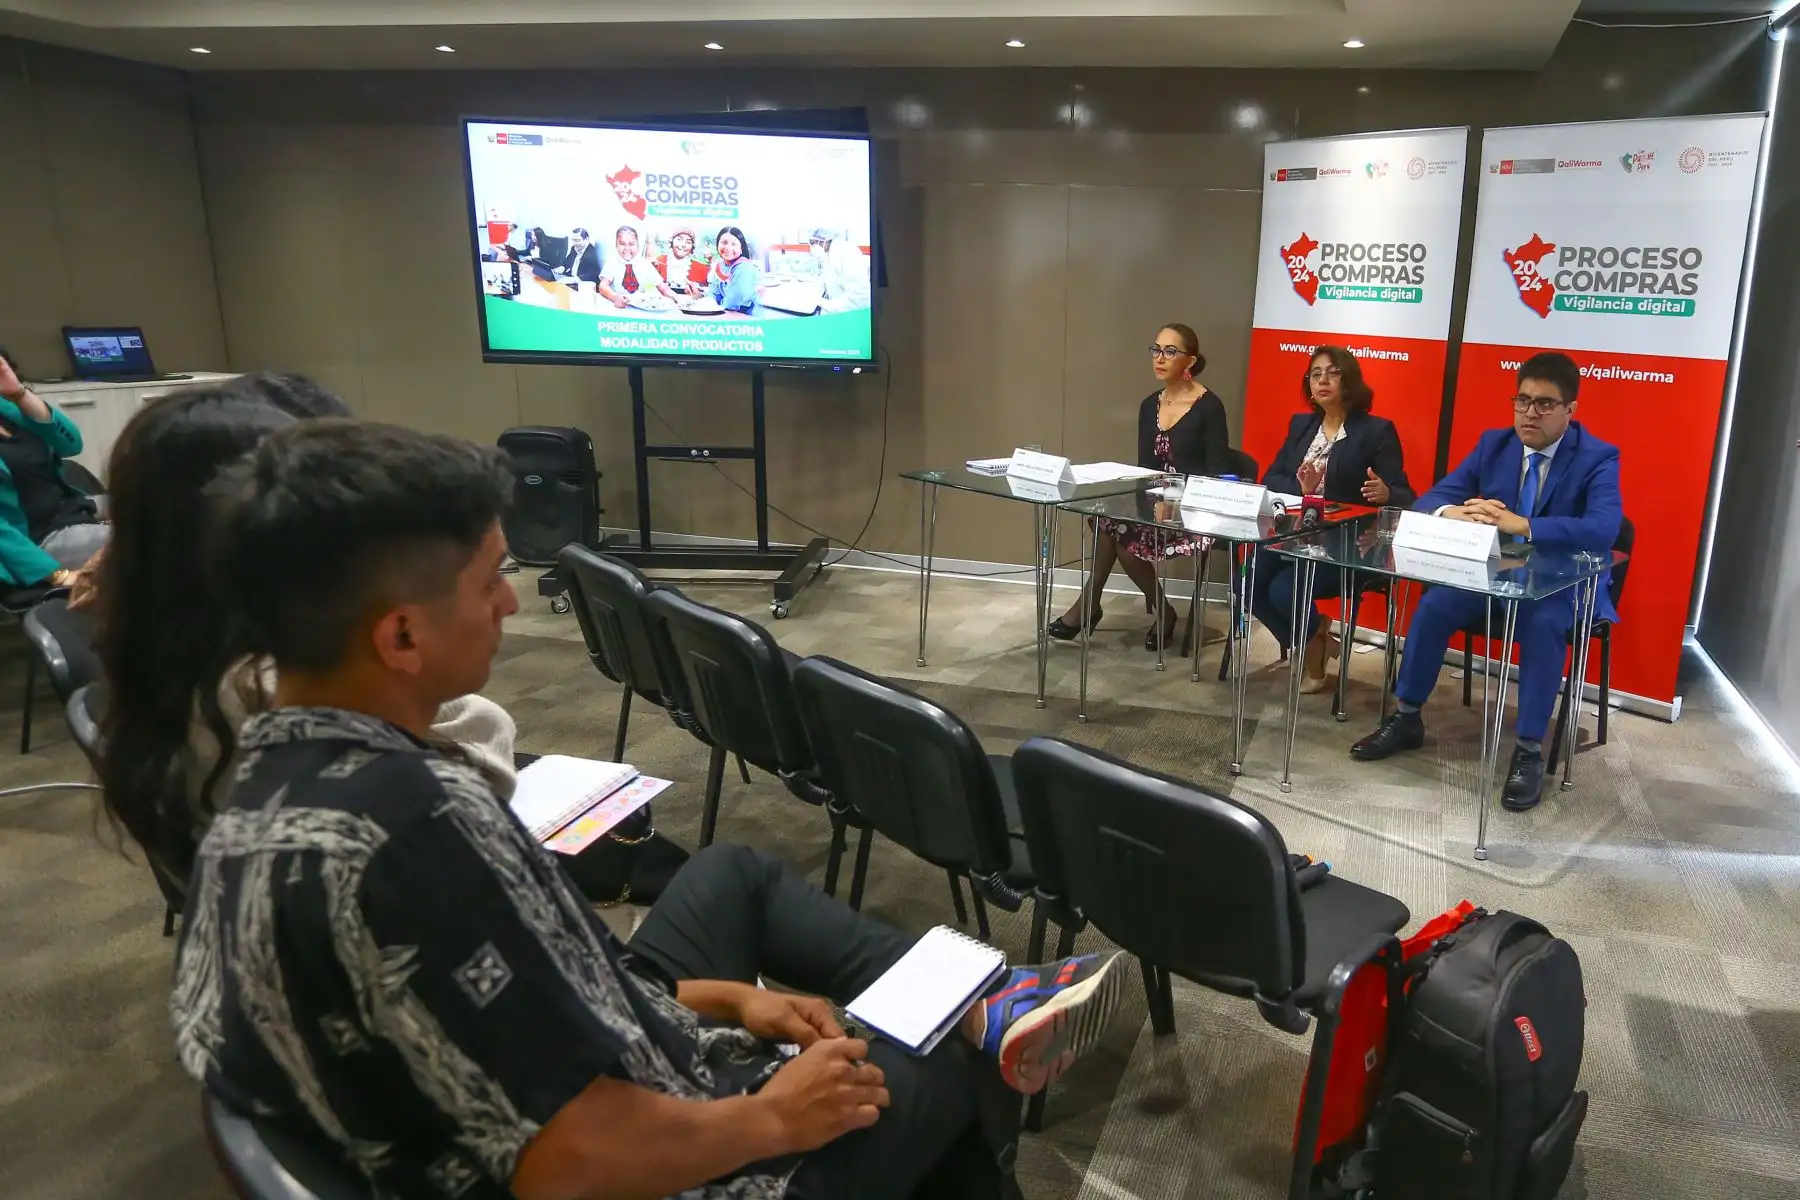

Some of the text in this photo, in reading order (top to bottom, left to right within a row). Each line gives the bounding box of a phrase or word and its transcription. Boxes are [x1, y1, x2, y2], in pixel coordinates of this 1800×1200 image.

[645, 173, 738, 190] PROCESO
[645, 189, 739, 206] COMPRAS
[1320, 243, 1427, 263] PROCESO
[1558, 246, 1703, 270] PROCESO
[1287, 255, 1305, 269] 20
[1513, 260, 1536, 275] 20
[1292, 269, 1310, 283] 24
[1318, 264, 1425, 285] COMPRAS
[1519, 276, 1543, 291] 24
[1554, 270, 1699, 296] COMPRAS
[1325, 286, 1416, 302] Vigilancia digital
[1563, 296, 1686, 314] Vigilancia digital
[597, 320, 765, 336] PRIMERA CONVOCATORIA
[600, 336, 764, 352] MODALIDAD PRODUCTOS
